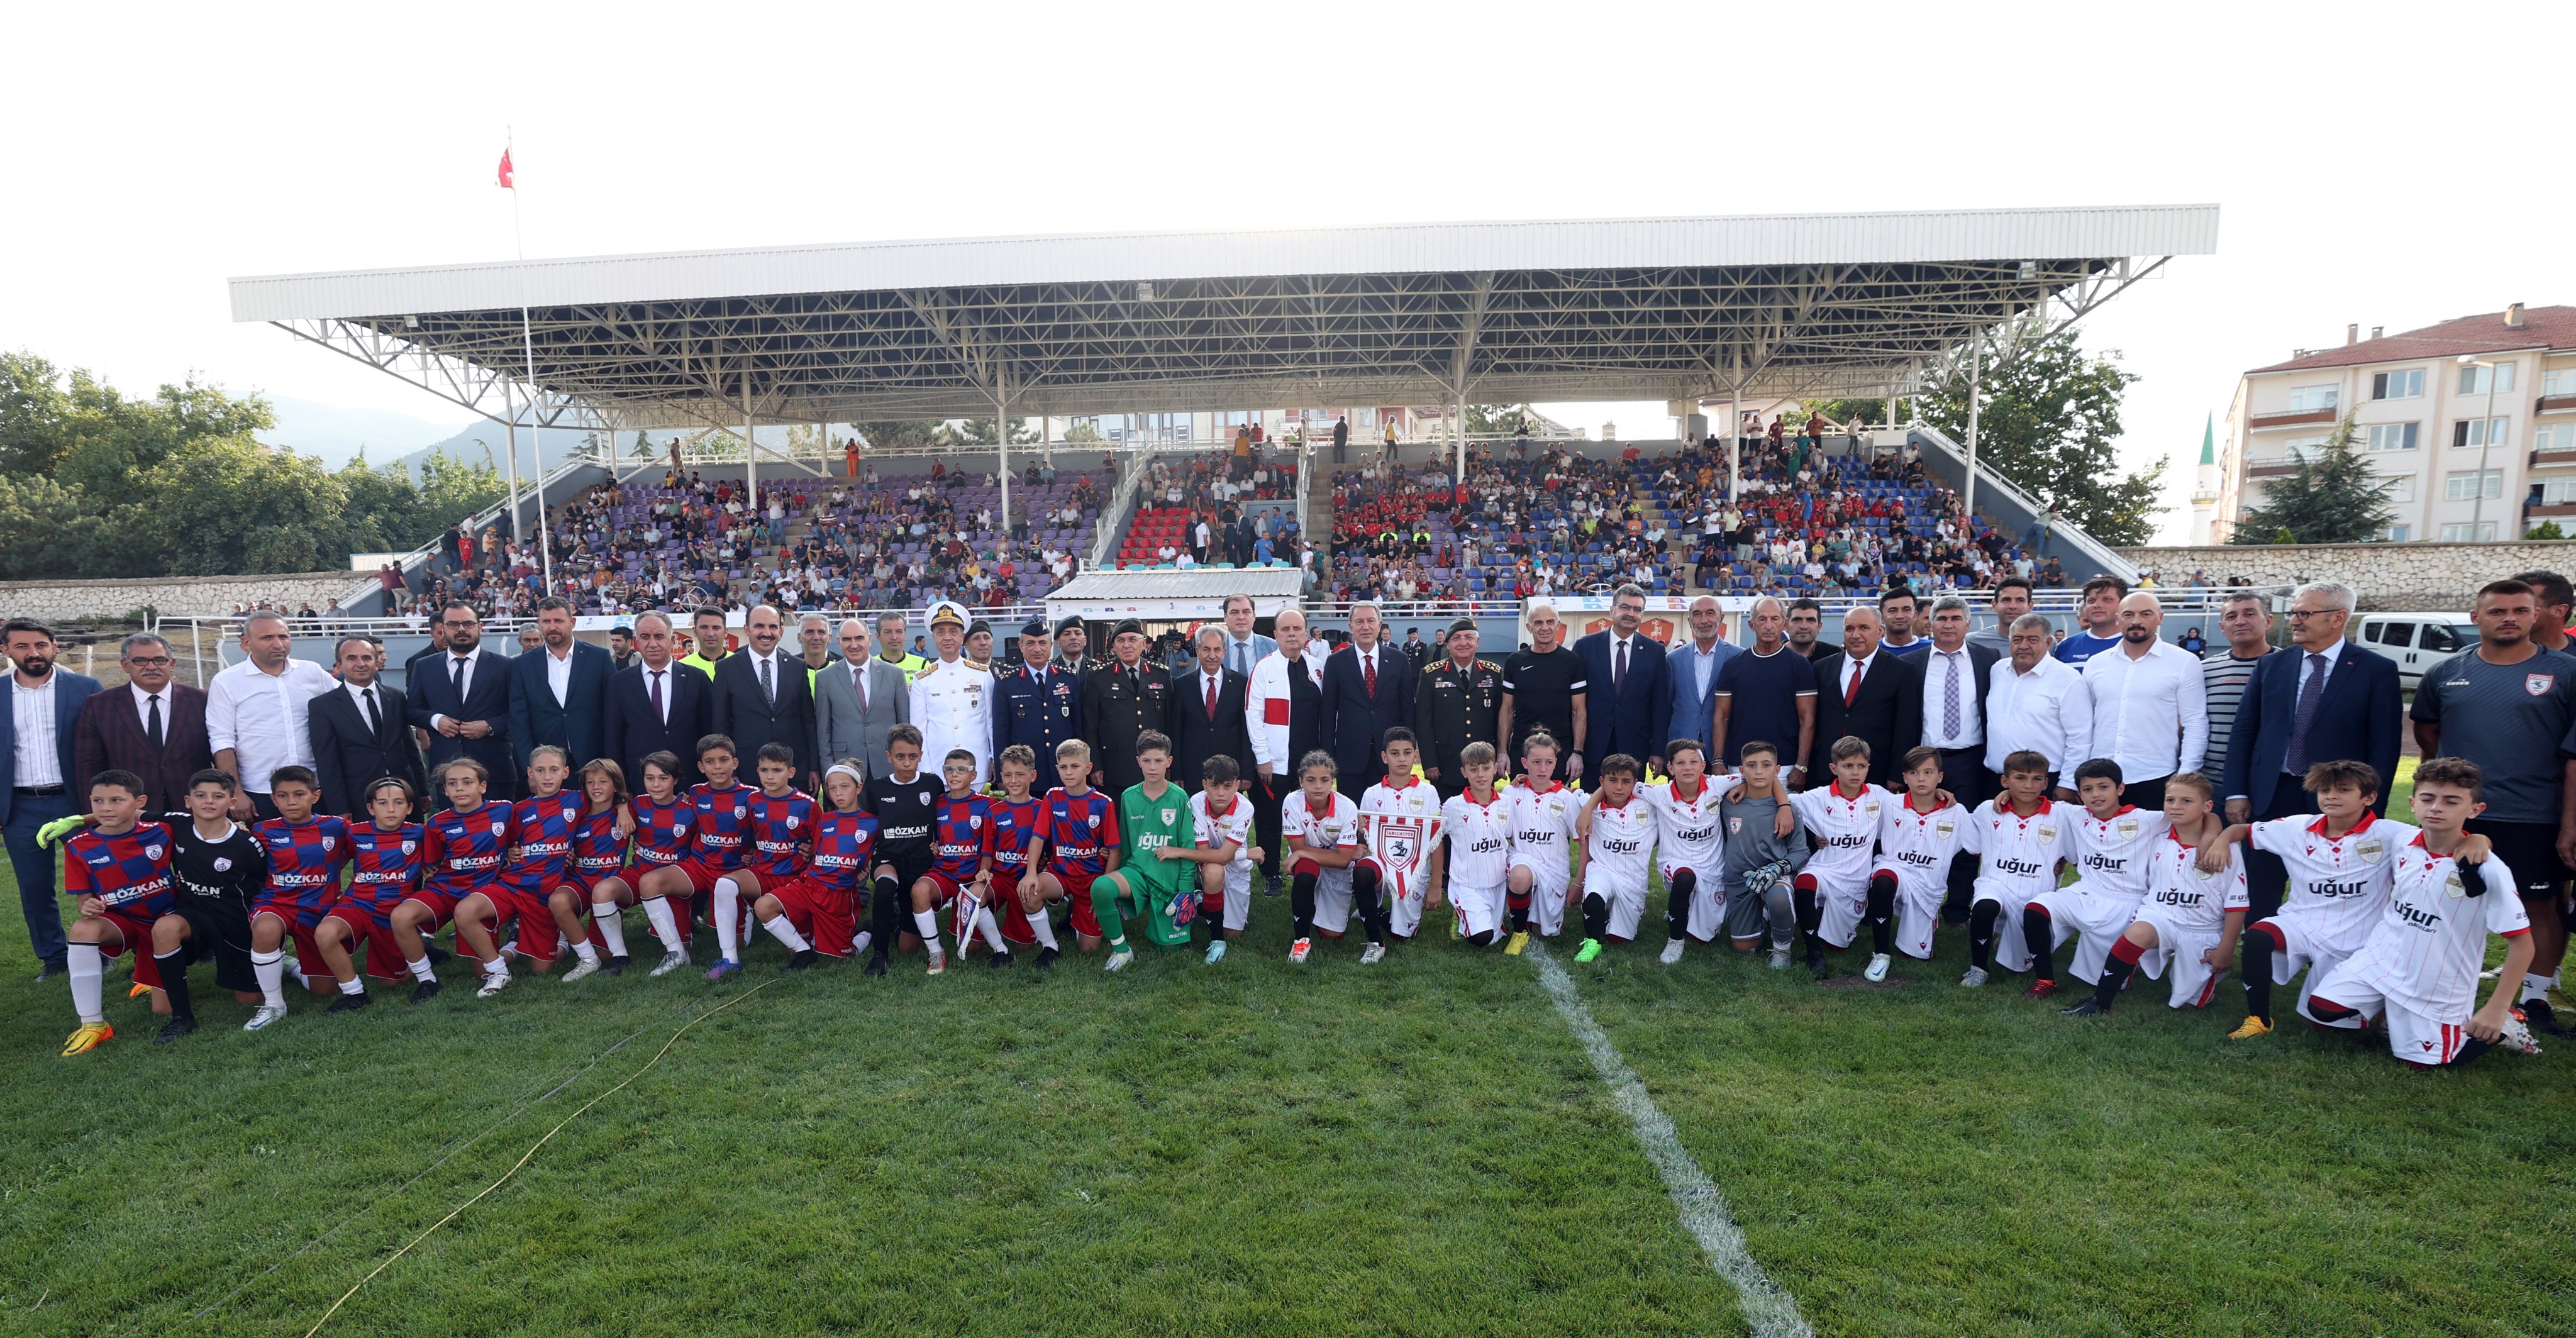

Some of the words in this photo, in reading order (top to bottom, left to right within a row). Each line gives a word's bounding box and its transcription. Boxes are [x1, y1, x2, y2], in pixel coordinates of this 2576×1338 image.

[894, 825, 927, 835] ÖZKAN
[1519, 828, 1555, 843] uğur
[1677, 826, 1714, 841] uğur
[707, 833, 741, 844] ÖZKAN
[1830, 833, 1870, 849] uğur
[531, 843, 569, 853] ÖZKAN
[764, 840, 795, 850] ÖZKAN
[943, 844, 978, 853] ÖZKAN
[1064, 846, 1097, 856] ÖZKAN
[1603, 839, 1640, 853] uğur
[462, 854, 501, 867] ÖZKAN
[583, 856, 620, 865] ÖZKAN
[643, 849, 678, 861] ÖZKAN
[823, 854, 858, 866] ÖZKAN
[1004, 851, 1028, 861] ÖZKA
[1897, 849, 1938, 865] uğur
[1996, 857, 2042, 874] uğur
[2084, 853, 2128, 870] uğur
[284, 874, 327, 883] ÖZKAN
[365, 870, 406, 880] ÖZKAN
[116, 877, 169, 899] ÖZKAN
[2309, 879, 2368, 898] uğur
[2157, 888, 2205, 905] uğur
[2394, 900, 2443, 927] uğur
[1169, 931, 1187, 939] macron
